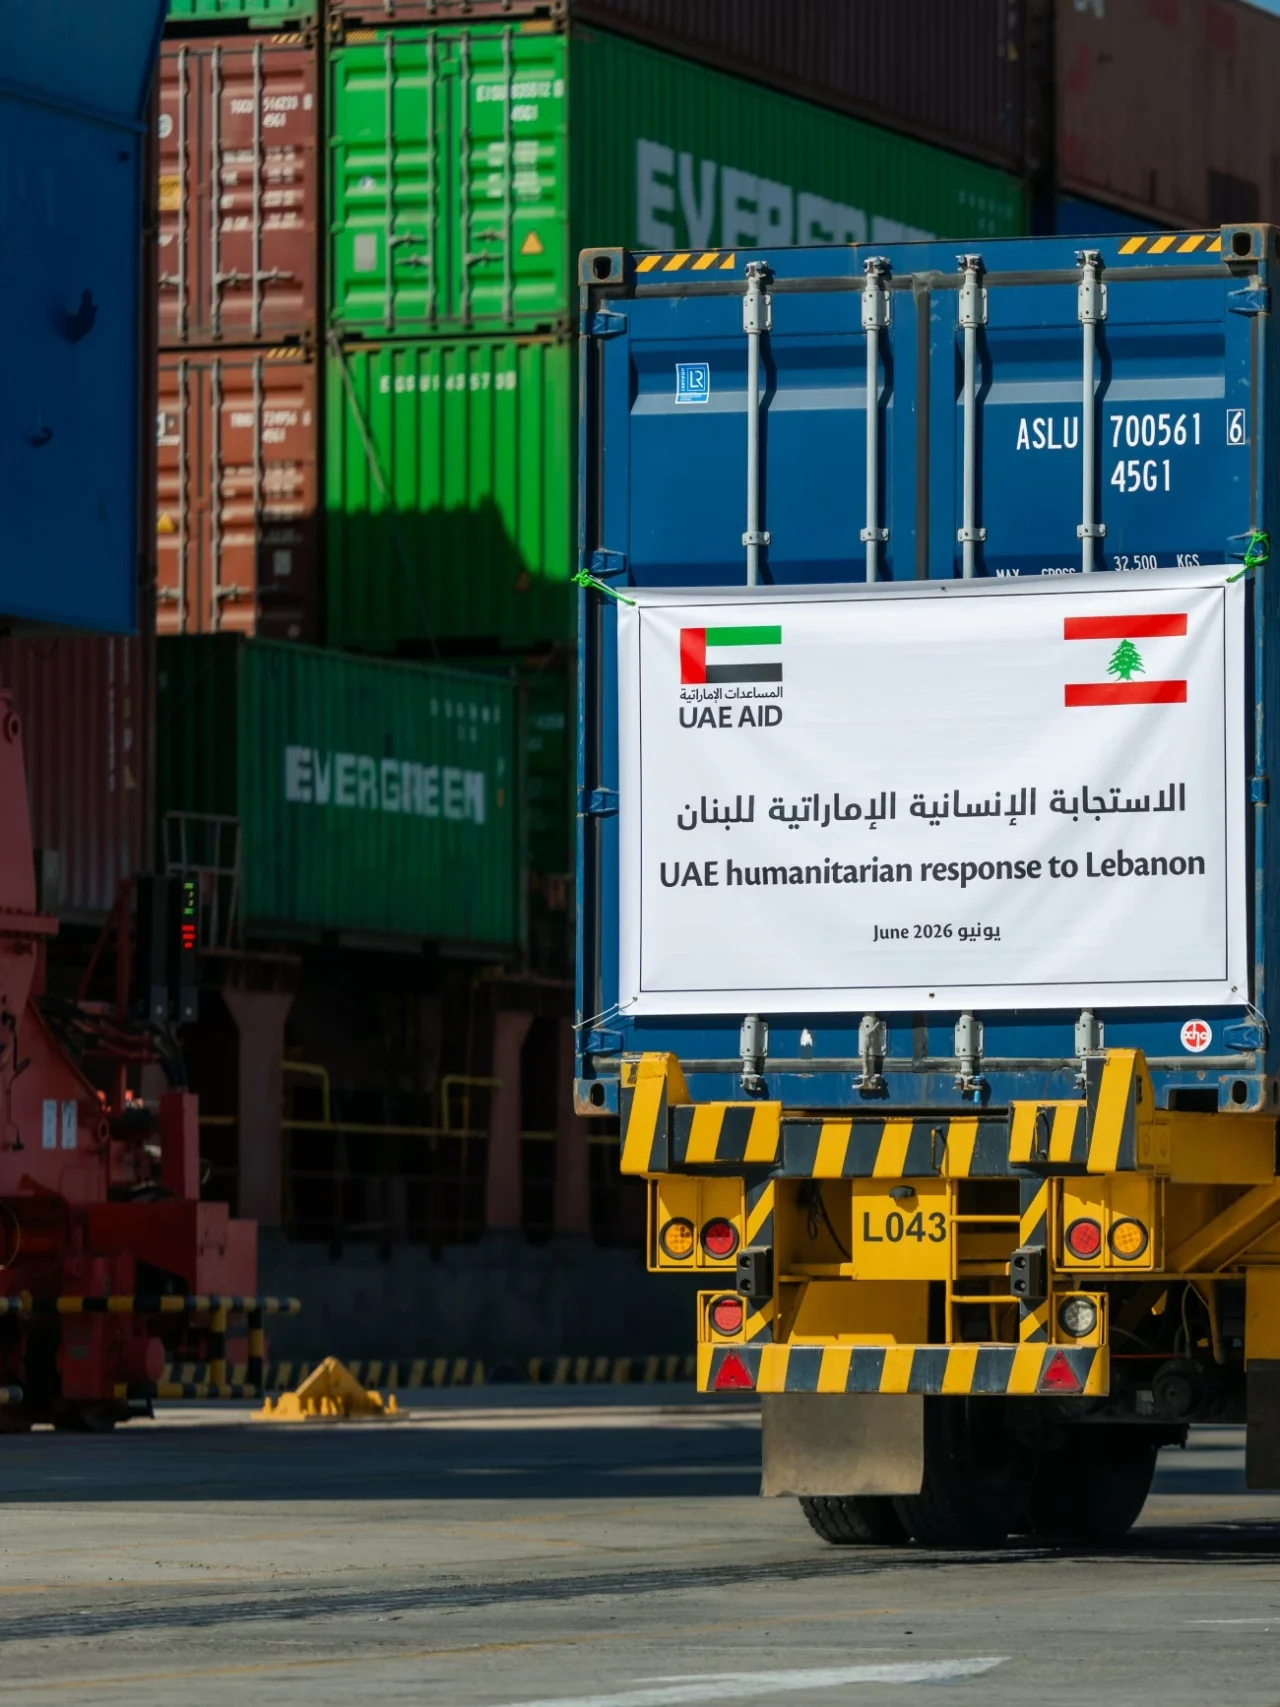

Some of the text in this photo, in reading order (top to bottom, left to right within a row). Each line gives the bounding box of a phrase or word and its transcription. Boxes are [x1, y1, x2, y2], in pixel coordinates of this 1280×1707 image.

[1016, 411, 1243, 450] ASLU 700561 6
[1110, 459, 1170, 492] 45G1
[1176, 553, 1200, 568] KGS
[679, 686, 783, 704] المساعدات الإماراتية
[679, 704, 783, 729] UAE AID
[285, 744, 486, 825] EVERGREEN
[677, 782, 1186, 831] الاستجابة الإنسانية الإماراتية للبنان
[660, 848, 1206, 889] UAE humanitarian response to Lebanon
[872, 921, 1002, 943] June 2026 يونيو
[862, 1211, 948, 1243] L043
